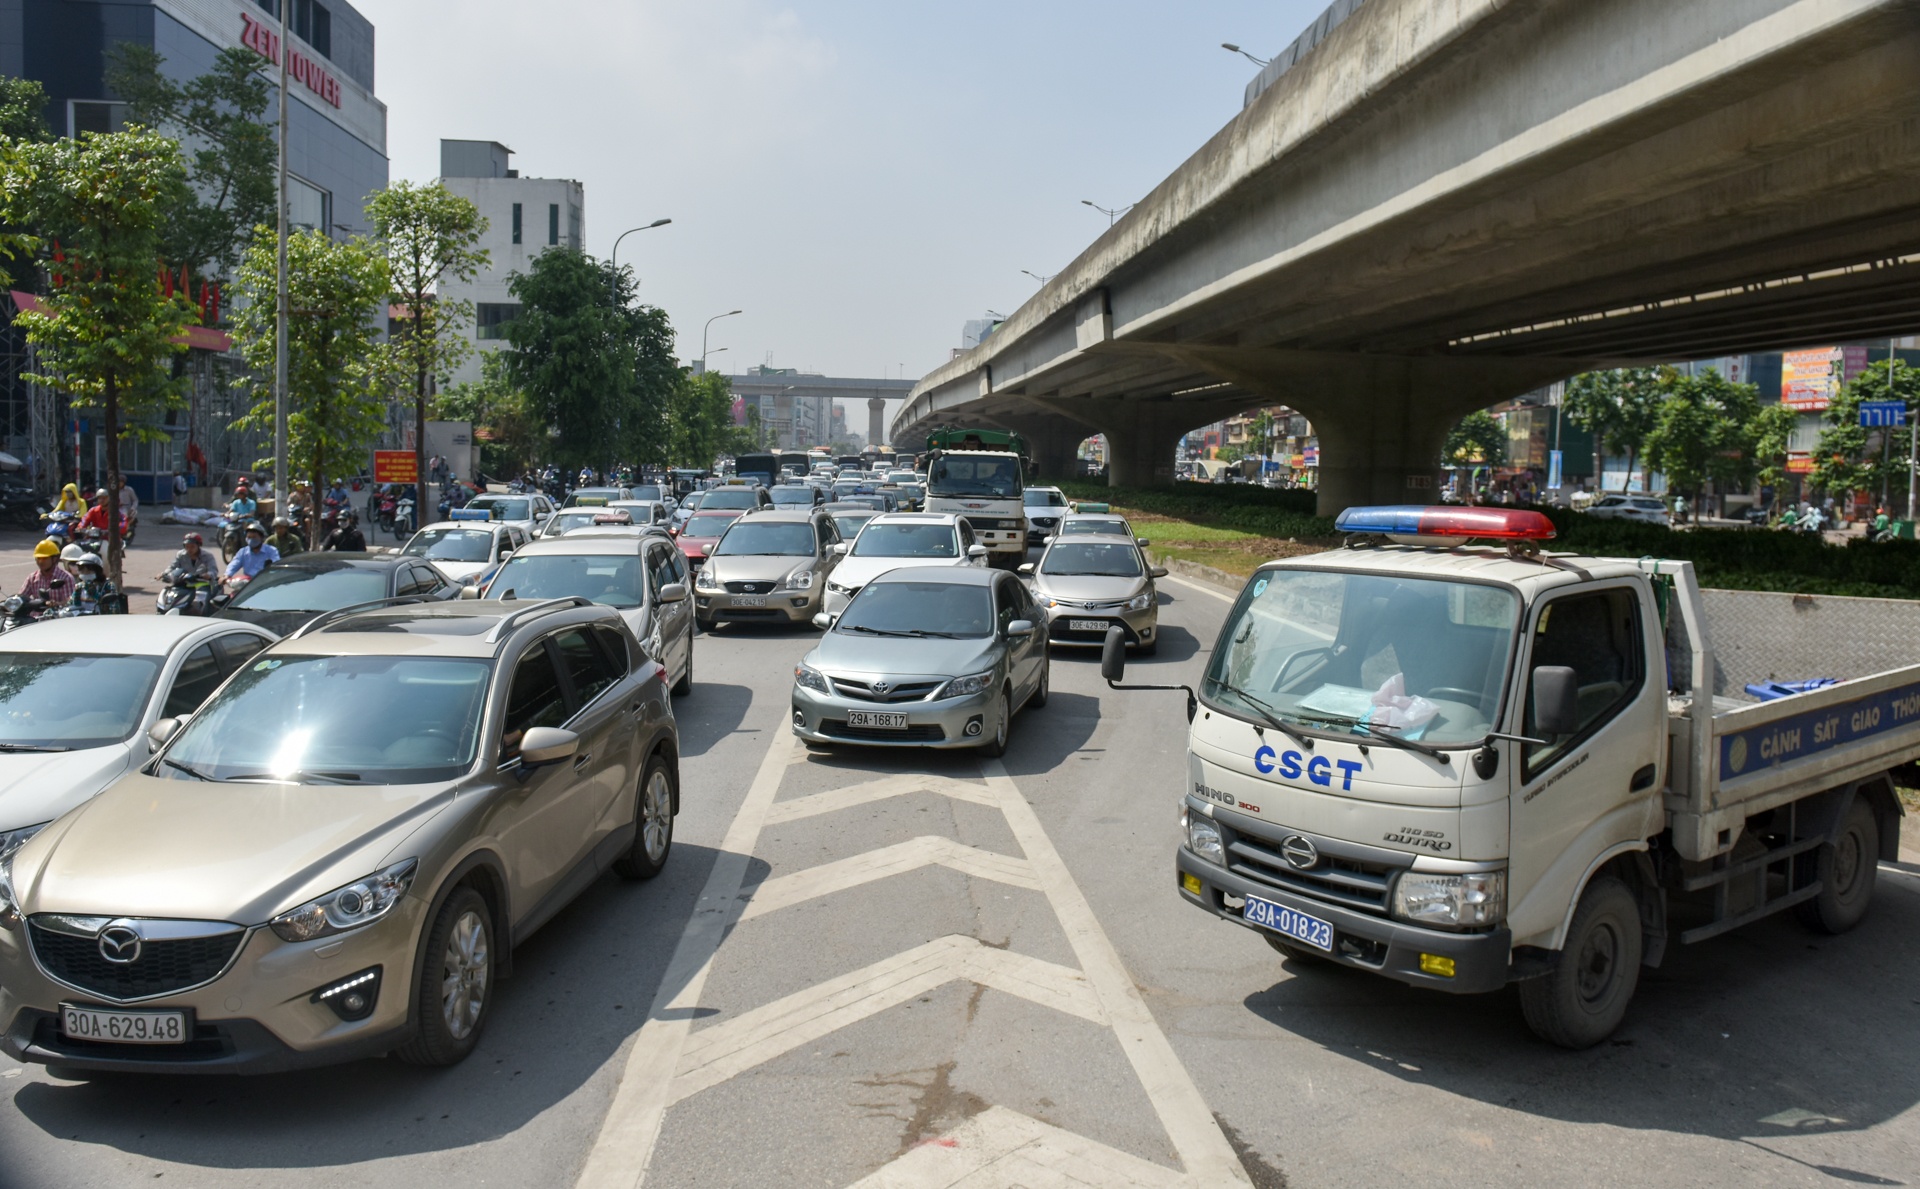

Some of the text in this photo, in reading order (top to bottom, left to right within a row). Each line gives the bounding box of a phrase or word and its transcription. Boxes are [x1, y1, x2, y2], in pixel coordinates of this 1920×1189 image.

[241, 12, 341, 110] ZEN TOWER
[850, 713, 905, 727] 29A-168.17
[1760, 727, 1800, 759] CẢNH
[1813, 713, 1841, 744] SÁT
[1851, 706, 1881, 732] GIAO
[1254, 745, 1363, 791] CSGT
[1195, 782, 1260, 813] HINO 300
[1383, 832, 1452, 852] DUTRO
[1422, 830, 1445, 839] SD
[1246, 898, 1330, 947] 29A-018.23
[67, 1012, 179, 1040] 30A-629.48
